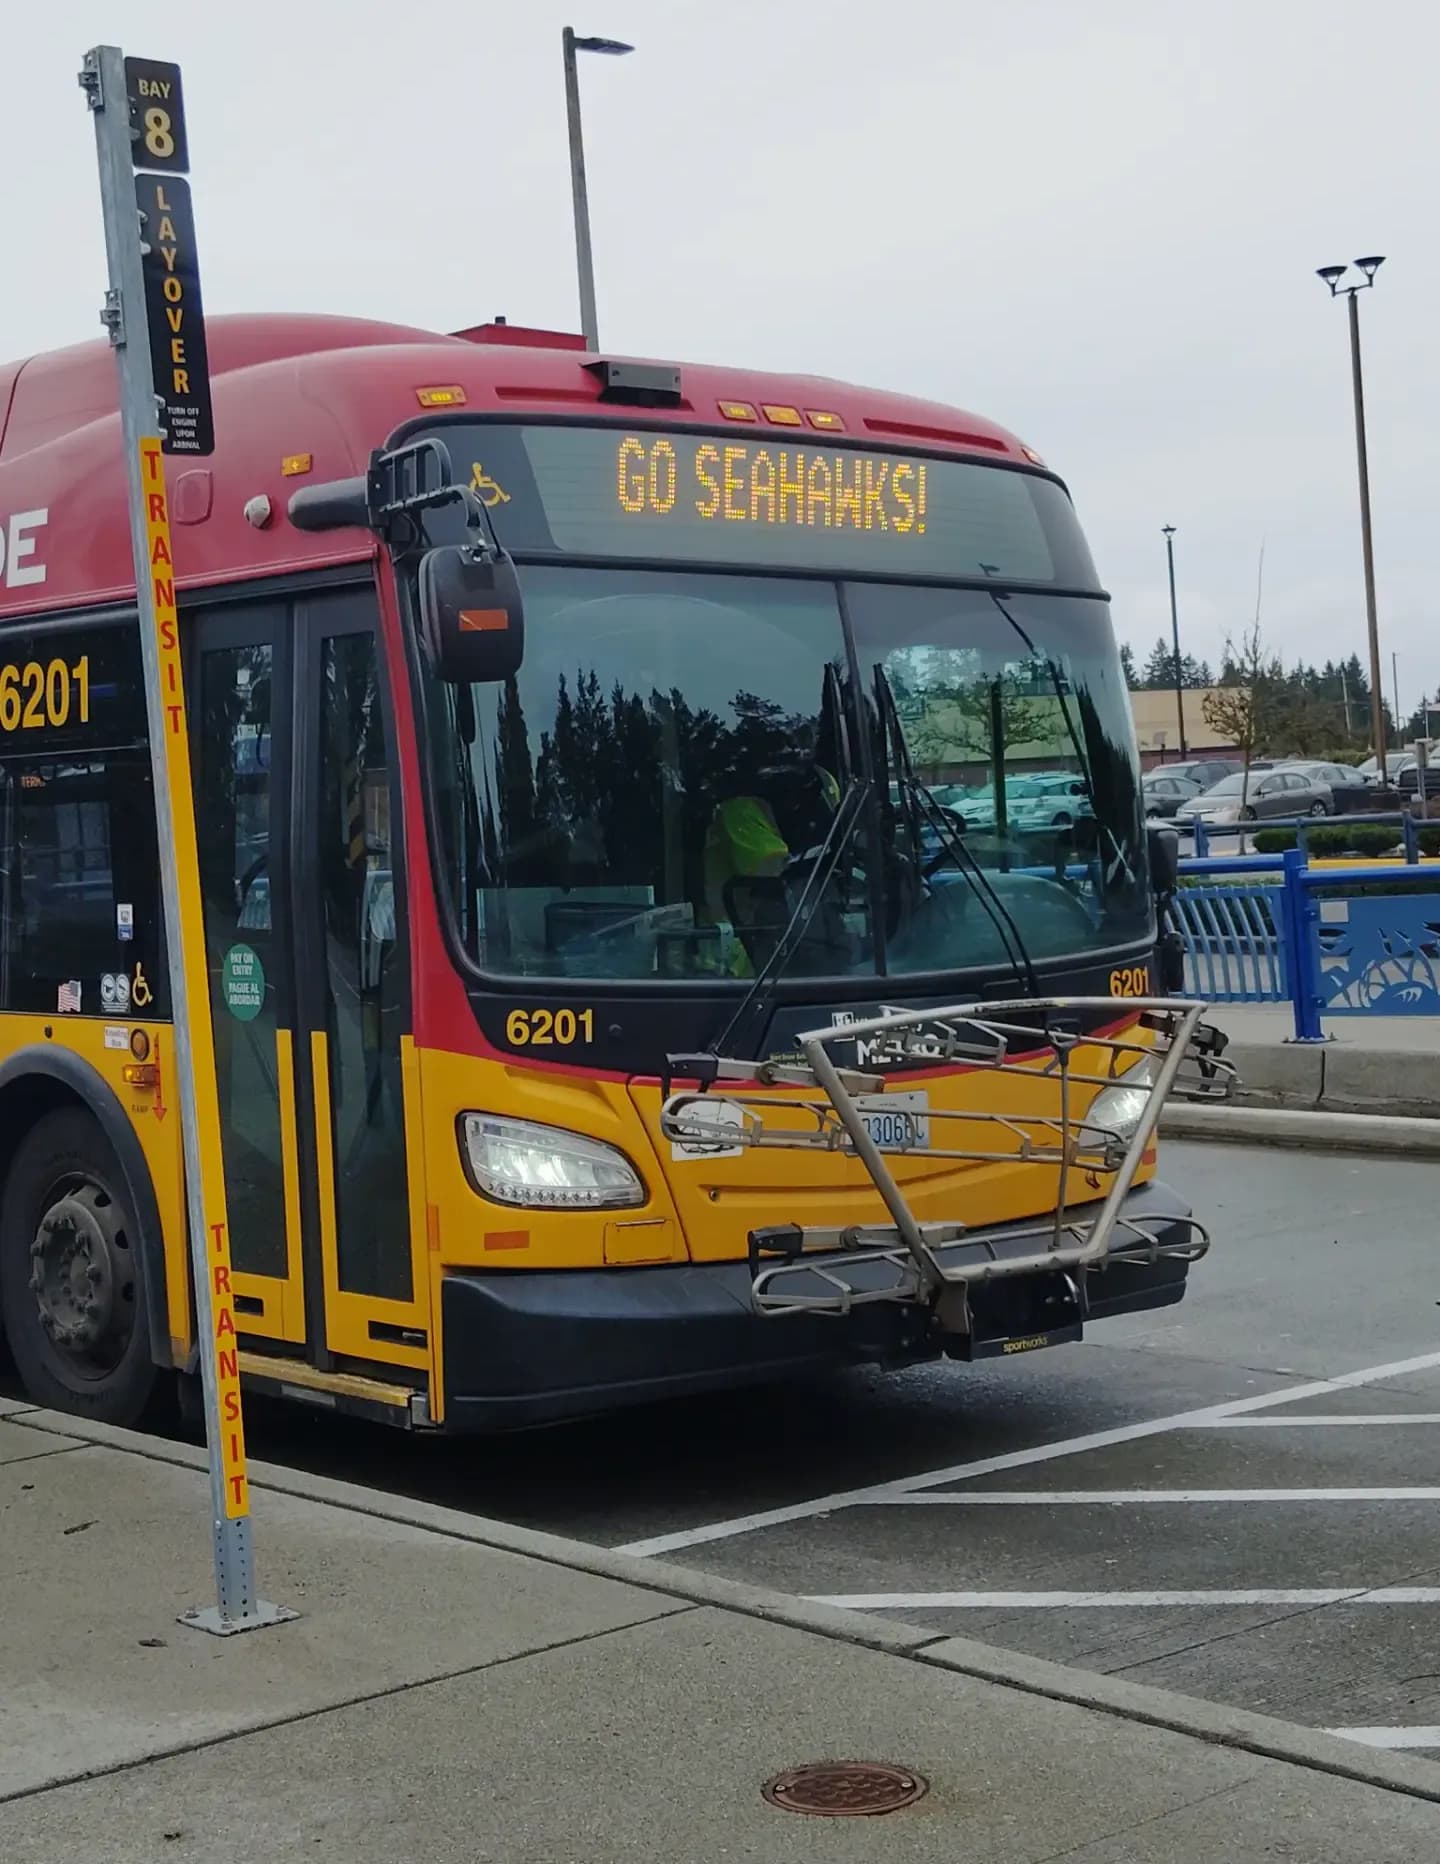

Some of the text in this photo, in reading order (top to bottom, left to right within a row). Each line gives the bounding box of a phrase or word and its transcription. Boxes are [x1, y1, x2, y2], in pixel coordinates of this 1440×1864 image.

[138, 79, 171, 99] BAY
[144, 107, 174, 158] 8
[156, 186, 191, 395] LAYOVER
[167, 406, 199, 416] TURN OFF
[172, 418, 197, 427] ENGINE
[173, 440, 200, 450] ARRIVAL
[176, 429, 195, 438] UPON
[617, 437, 927, 534] GO SEAHAWKS!
[0, 508, 48, 588] E
[144, 451, 182, 734] TRANSIT
[0, 656, 89, 731] 6201
[232, 965, 253, 976] ENTRY
[1110, 965, 1149, 998] 6201
[506, 1009, 593, 1046] 6201
[210, 1223, 245, 1505] TRANSIT
